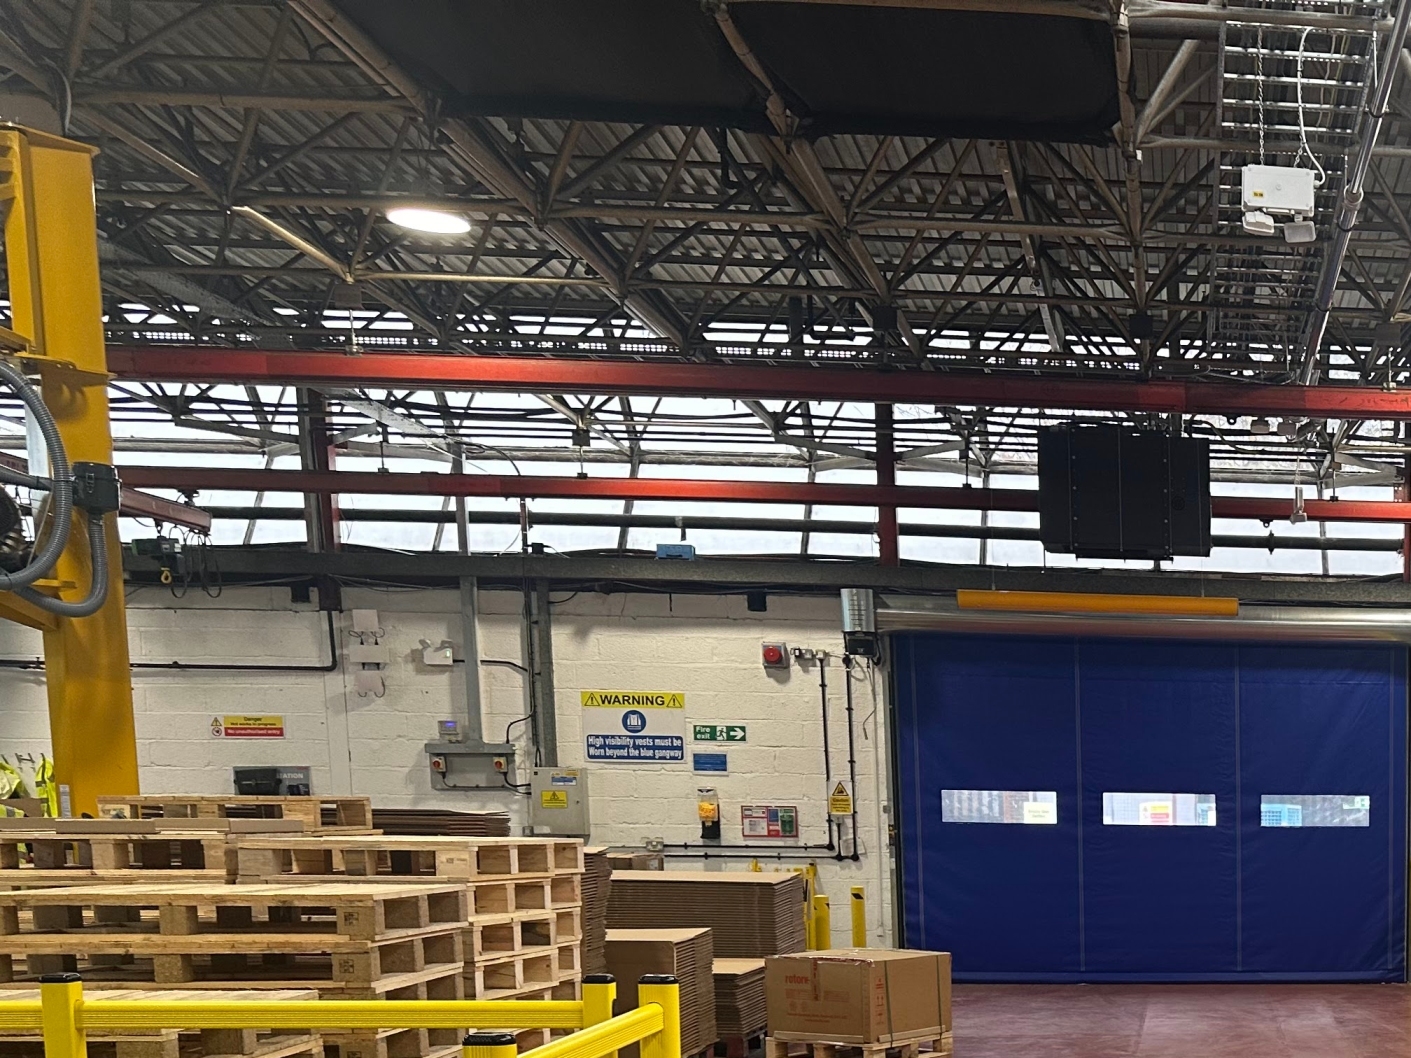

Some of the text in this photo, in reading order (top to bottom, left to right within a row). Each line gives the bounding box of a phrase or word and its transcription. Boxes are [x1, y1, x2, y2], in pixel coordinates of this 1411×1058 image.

[599, 693, 665, 706] WARNING
[695, 725, 711, 733] Fire
[588, 736, 682, 748] High visibility vests must be
[696, 732, 711, 740] exit
[588, 746, 683, 760] Worn beyond the blue gangway
